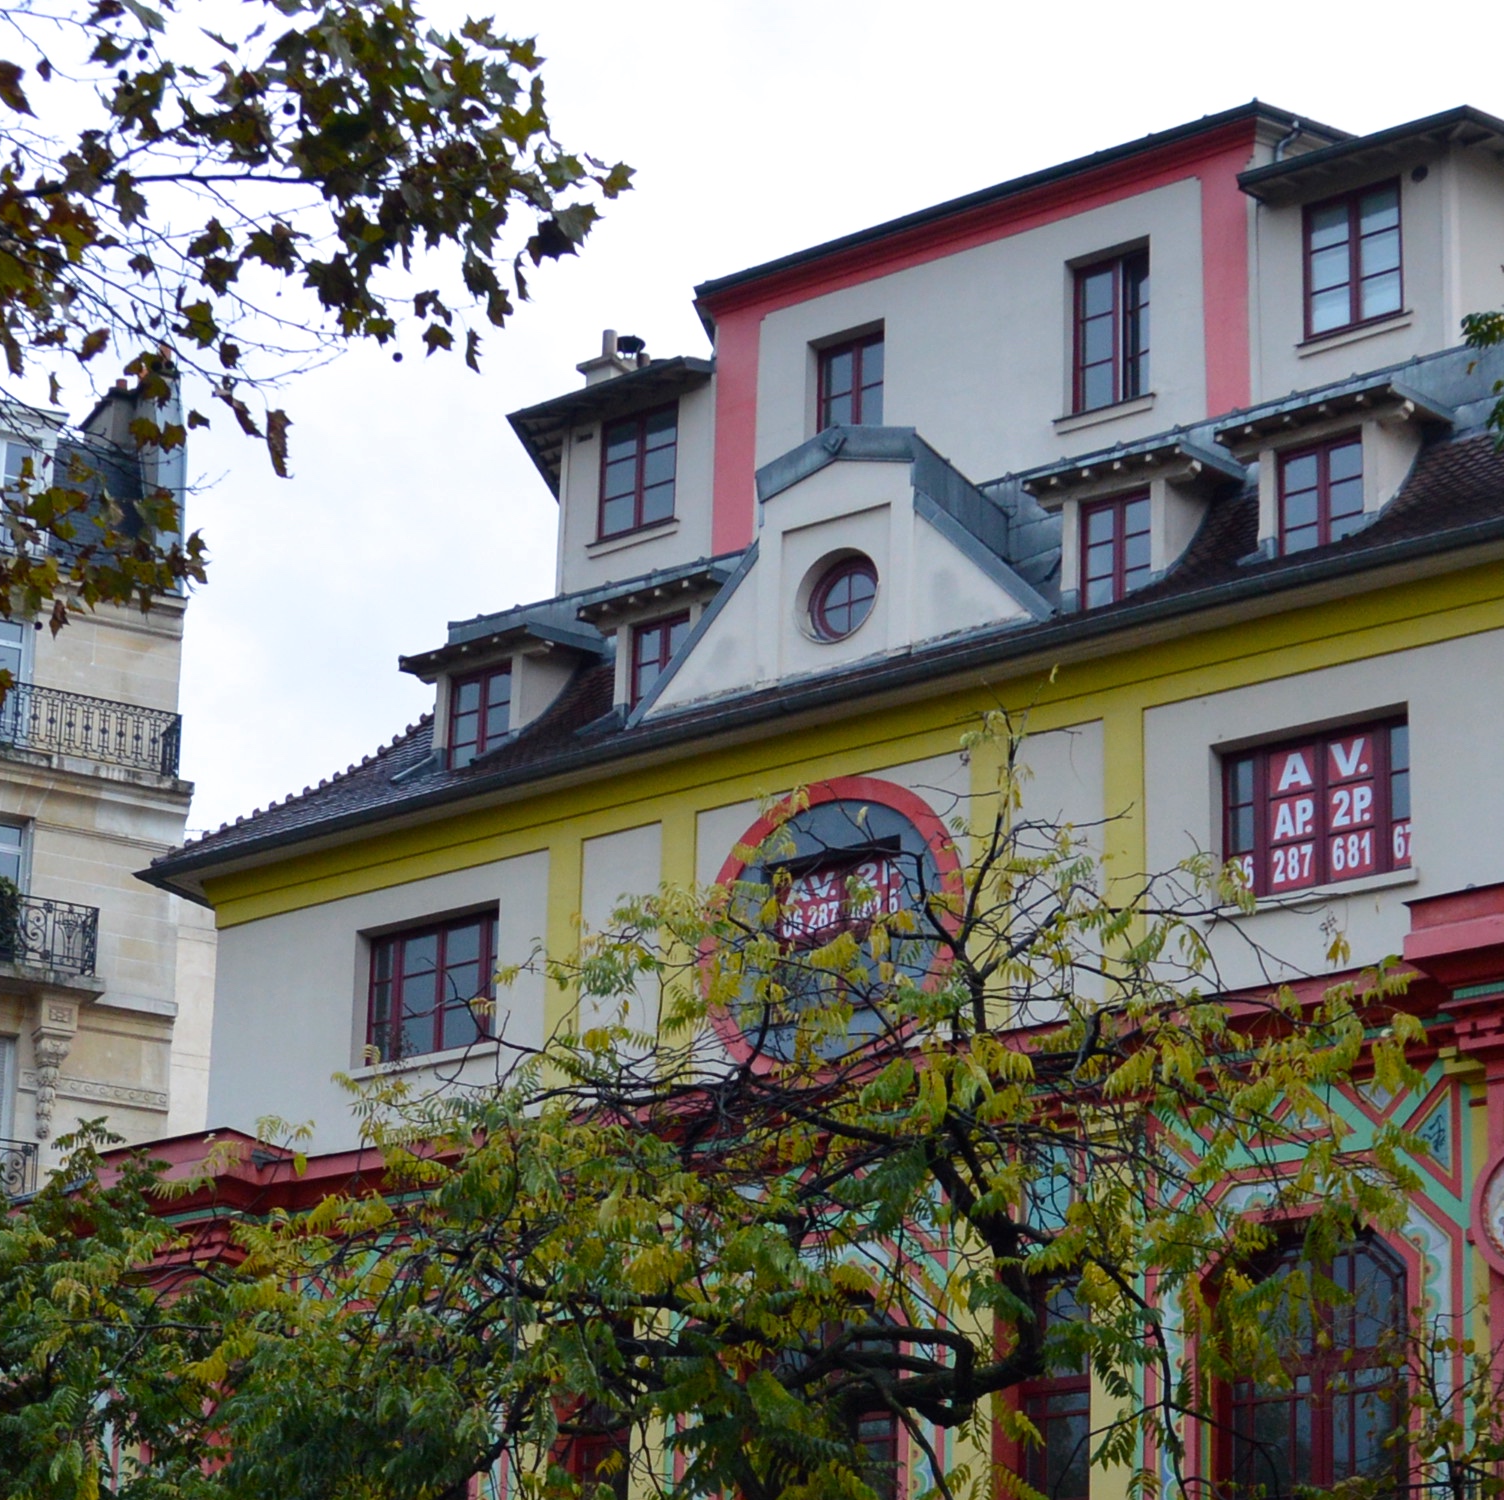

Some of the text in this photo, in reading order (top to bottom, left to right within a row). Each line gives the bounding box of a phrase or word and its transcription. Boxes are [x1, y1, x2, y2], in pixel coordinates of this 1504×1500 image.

[1277, 738, 1369, 791] A V.
[1273, 785, 1372, 840] AP. 2P.
[1273, 844, 1313, 884] 287
[1332, 831, 1372, 872] 681
[807, 900, 839, 933] 287
